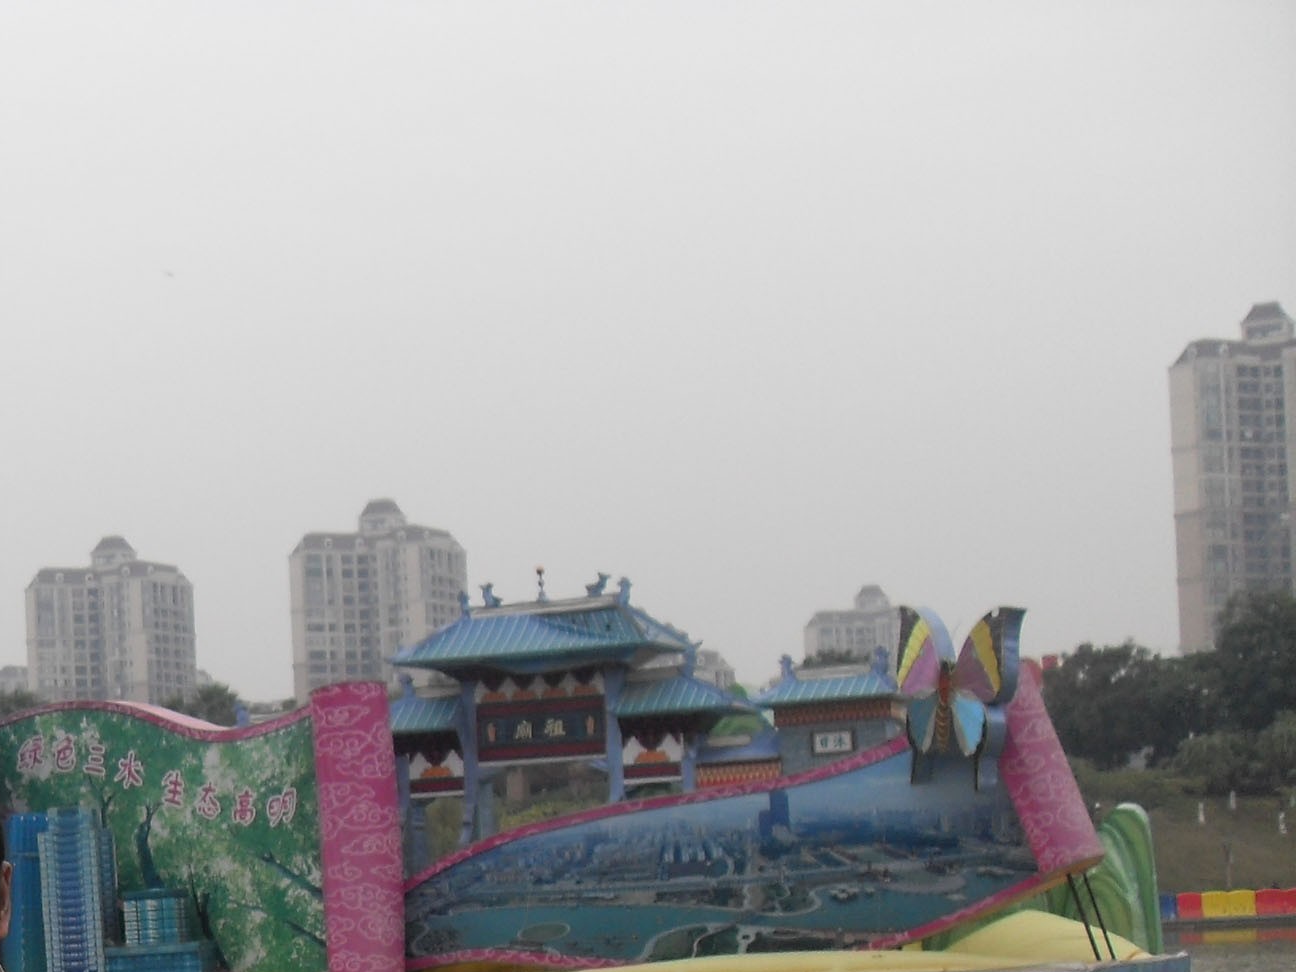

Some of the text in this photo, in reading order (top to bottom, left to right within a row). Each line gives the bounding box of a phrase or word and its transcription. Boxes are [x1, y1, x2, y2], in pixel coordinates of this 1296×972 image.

[16, 735, 298, 828] 绿色三水 生态高明
